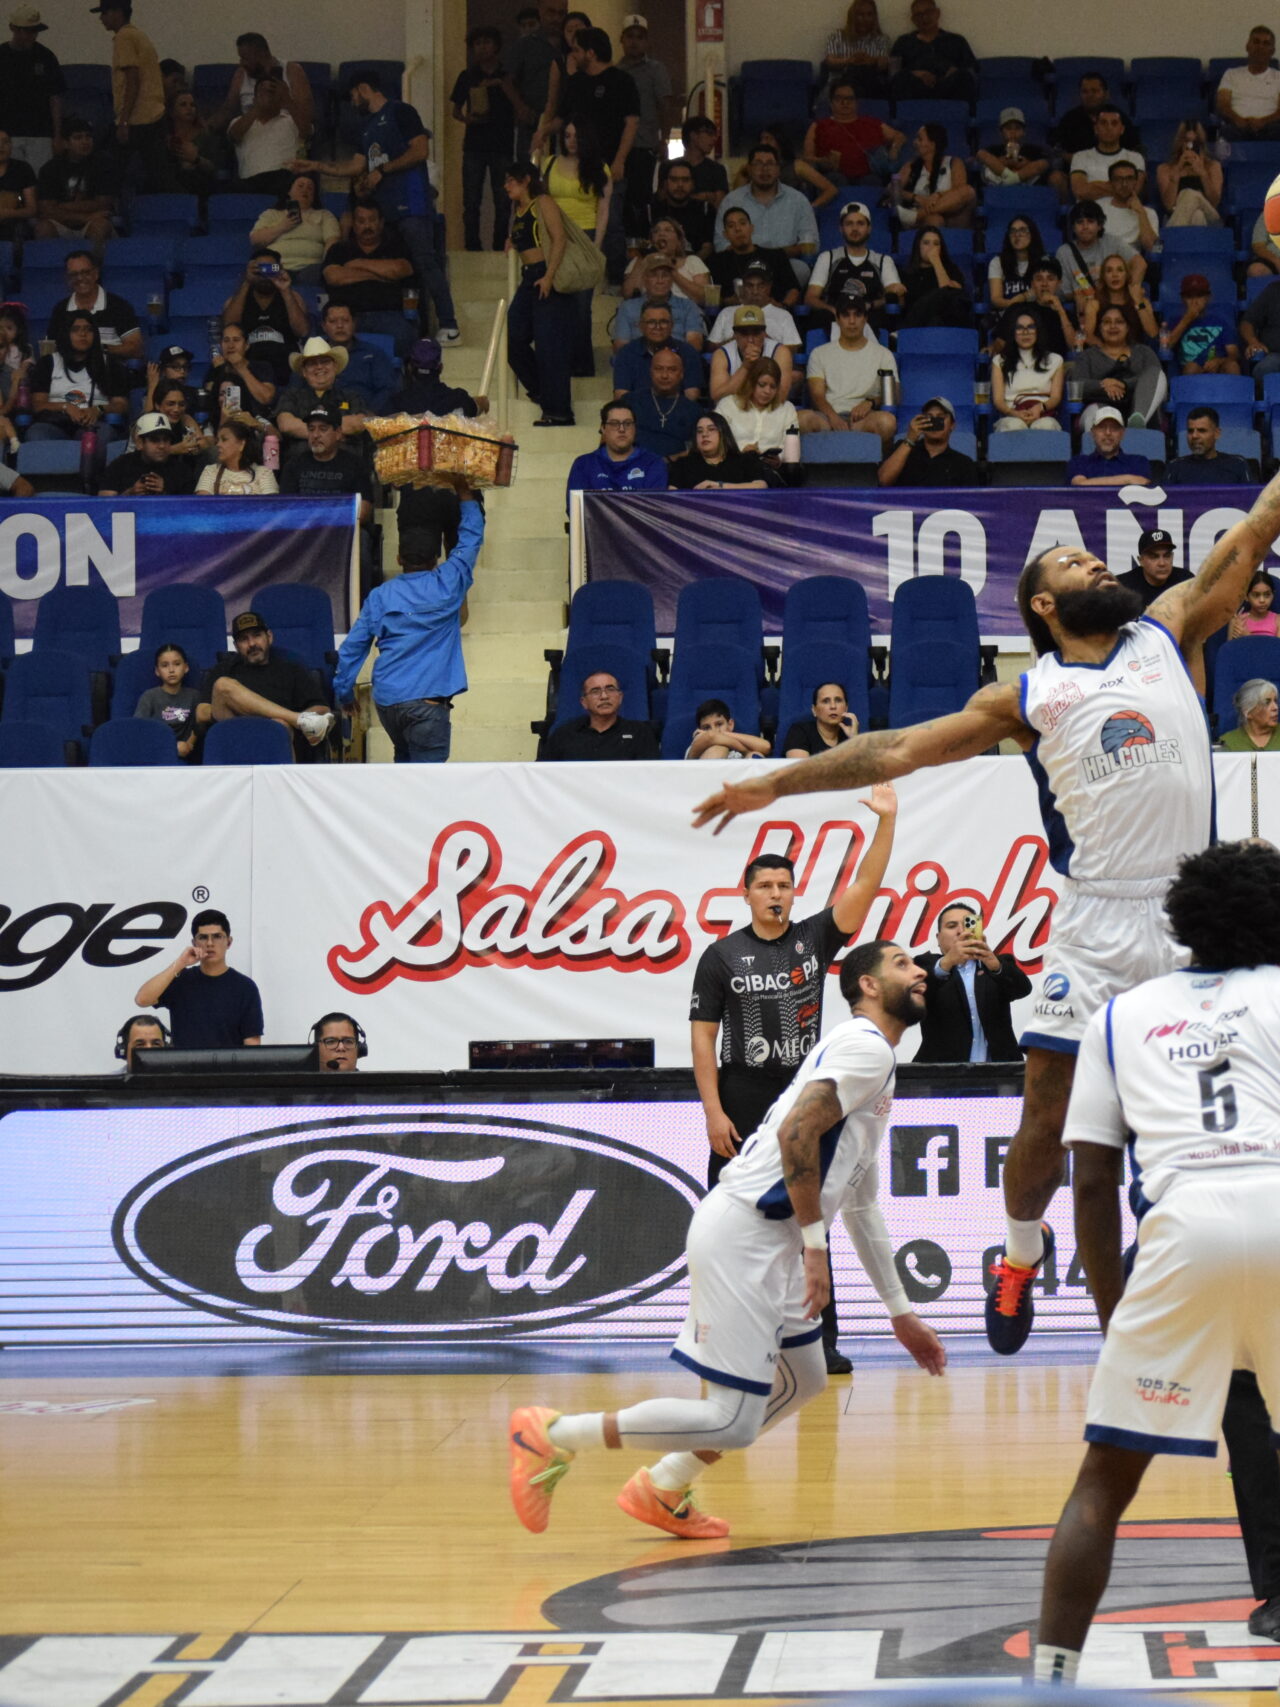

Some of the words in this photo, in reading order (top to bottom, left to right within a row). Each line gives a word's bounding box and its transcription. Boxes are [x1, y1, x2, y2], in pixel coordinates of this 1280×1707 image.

[871, 509, 987, 602] 10
[1099, 676, 1124, 690] ADX
[1081, 738, 1183, 784] HALCONES
[328, 821, 692, 995] Salsa
[0, 902, 188, 992] ge
[1033, 1002, 1076, 1019] MEGA
[1198, 1058, 1239, 1133] 5
[1243, 1140, 1267, 1154] San
[235, 1148, 597, 1295] Ford
[1136, 1377, 1179, 1392] 105.7
